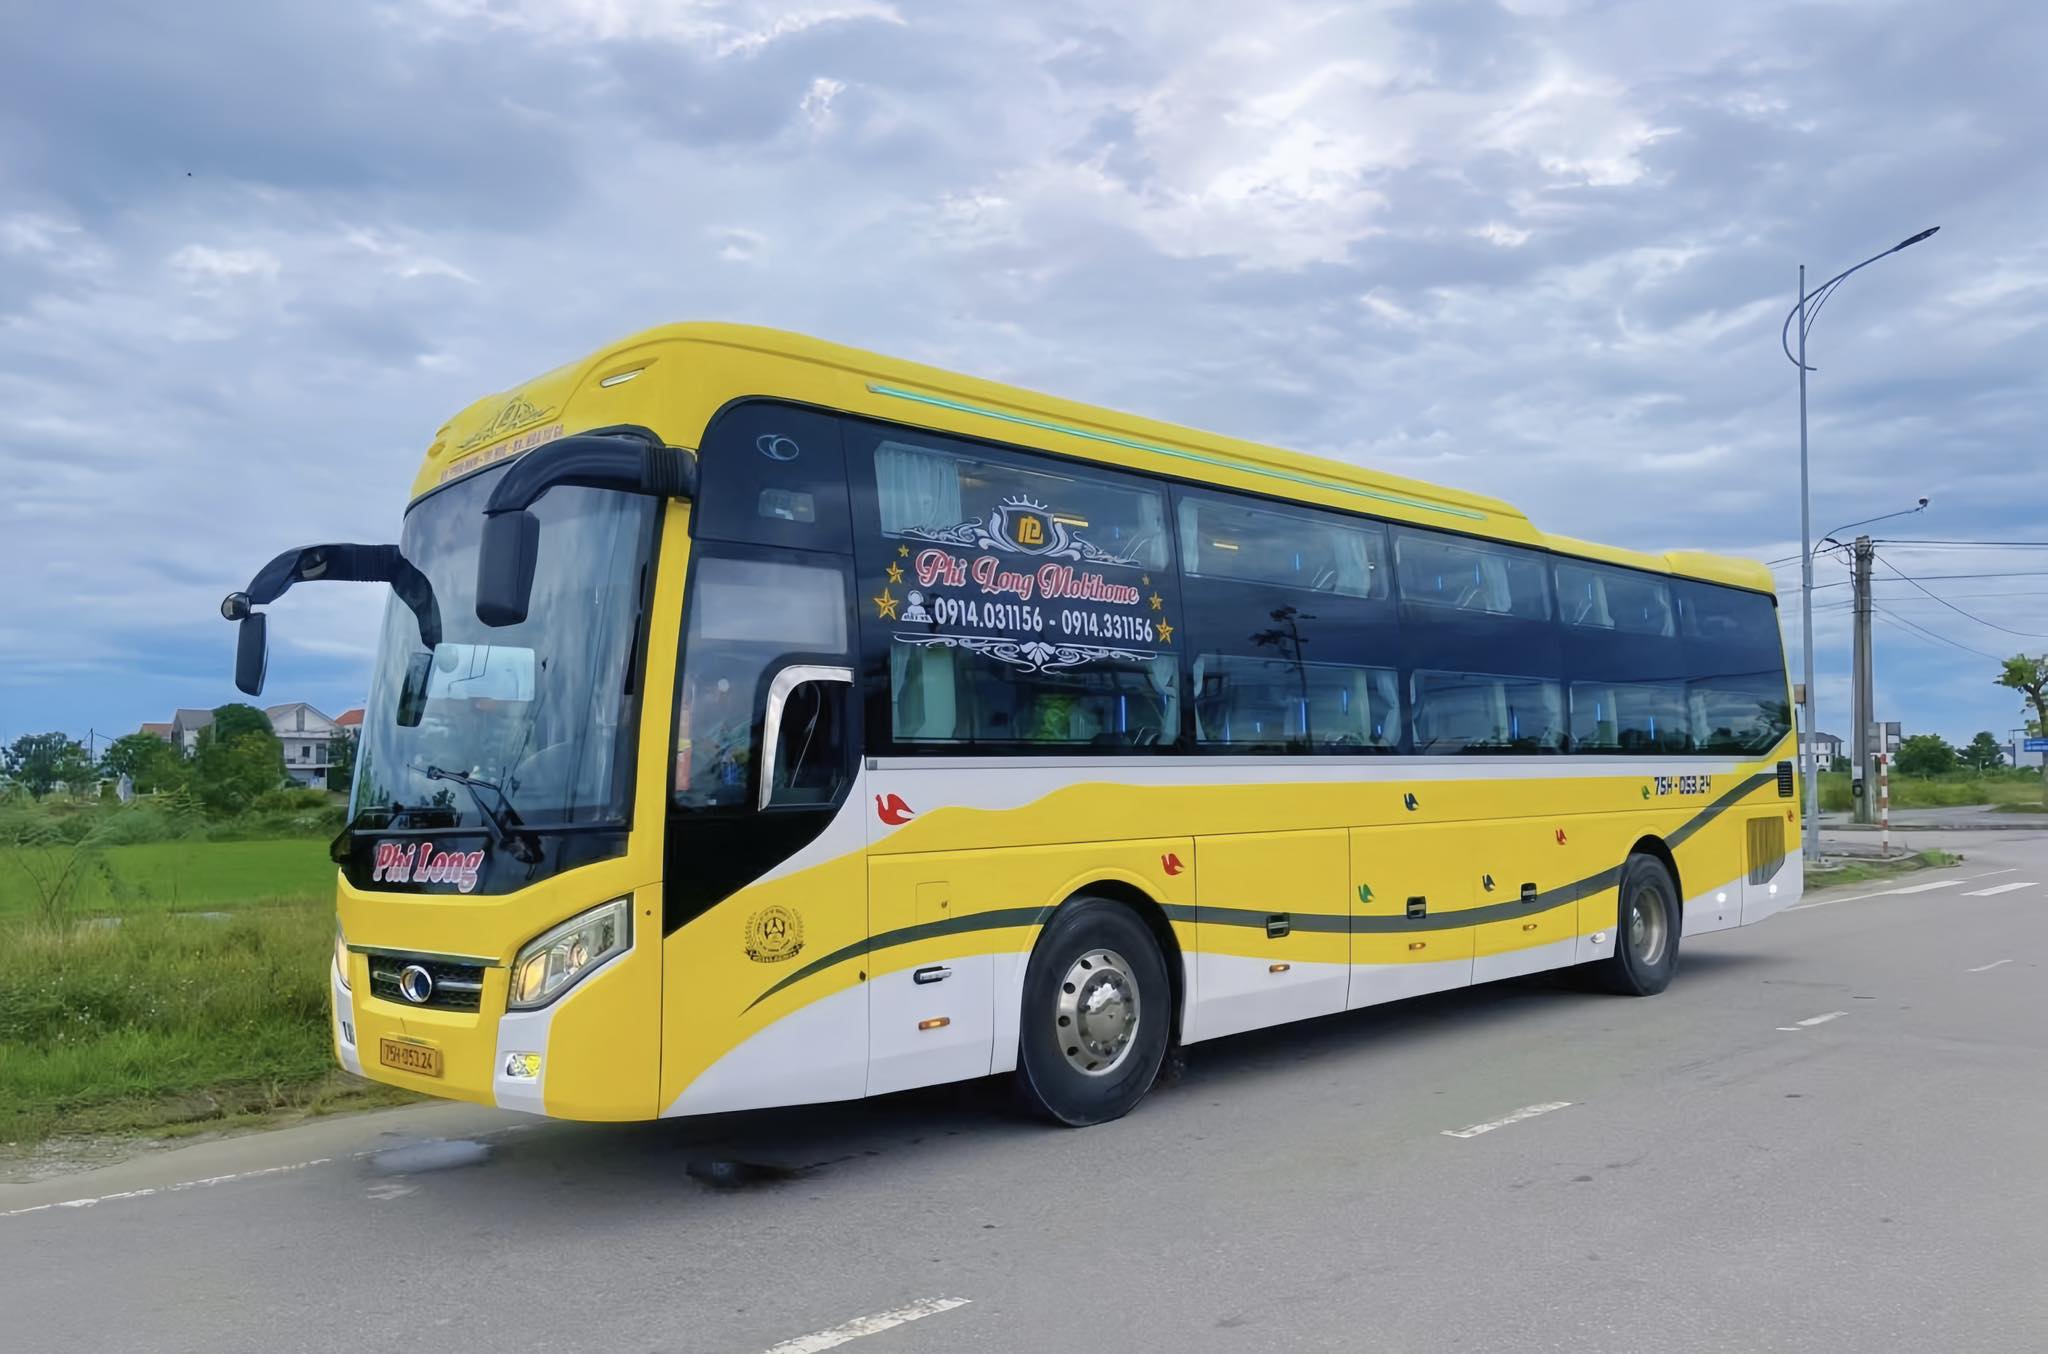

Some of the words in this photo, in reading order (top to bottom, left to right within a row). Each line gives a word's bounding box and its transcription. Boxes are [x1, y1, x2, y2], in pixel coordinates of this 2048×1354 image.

[915, 549, 966, 587] Phi
[972, 556, 1034, 600] Long
[1037, 562, 1140, 604] Mobihome
[934, 597, 1043, 632] 0914.031156
[1061, 609, 1153, 642] 0914.331156
[373, 843, 416, 882] Phi
[412, 842, 485, 893] Long
